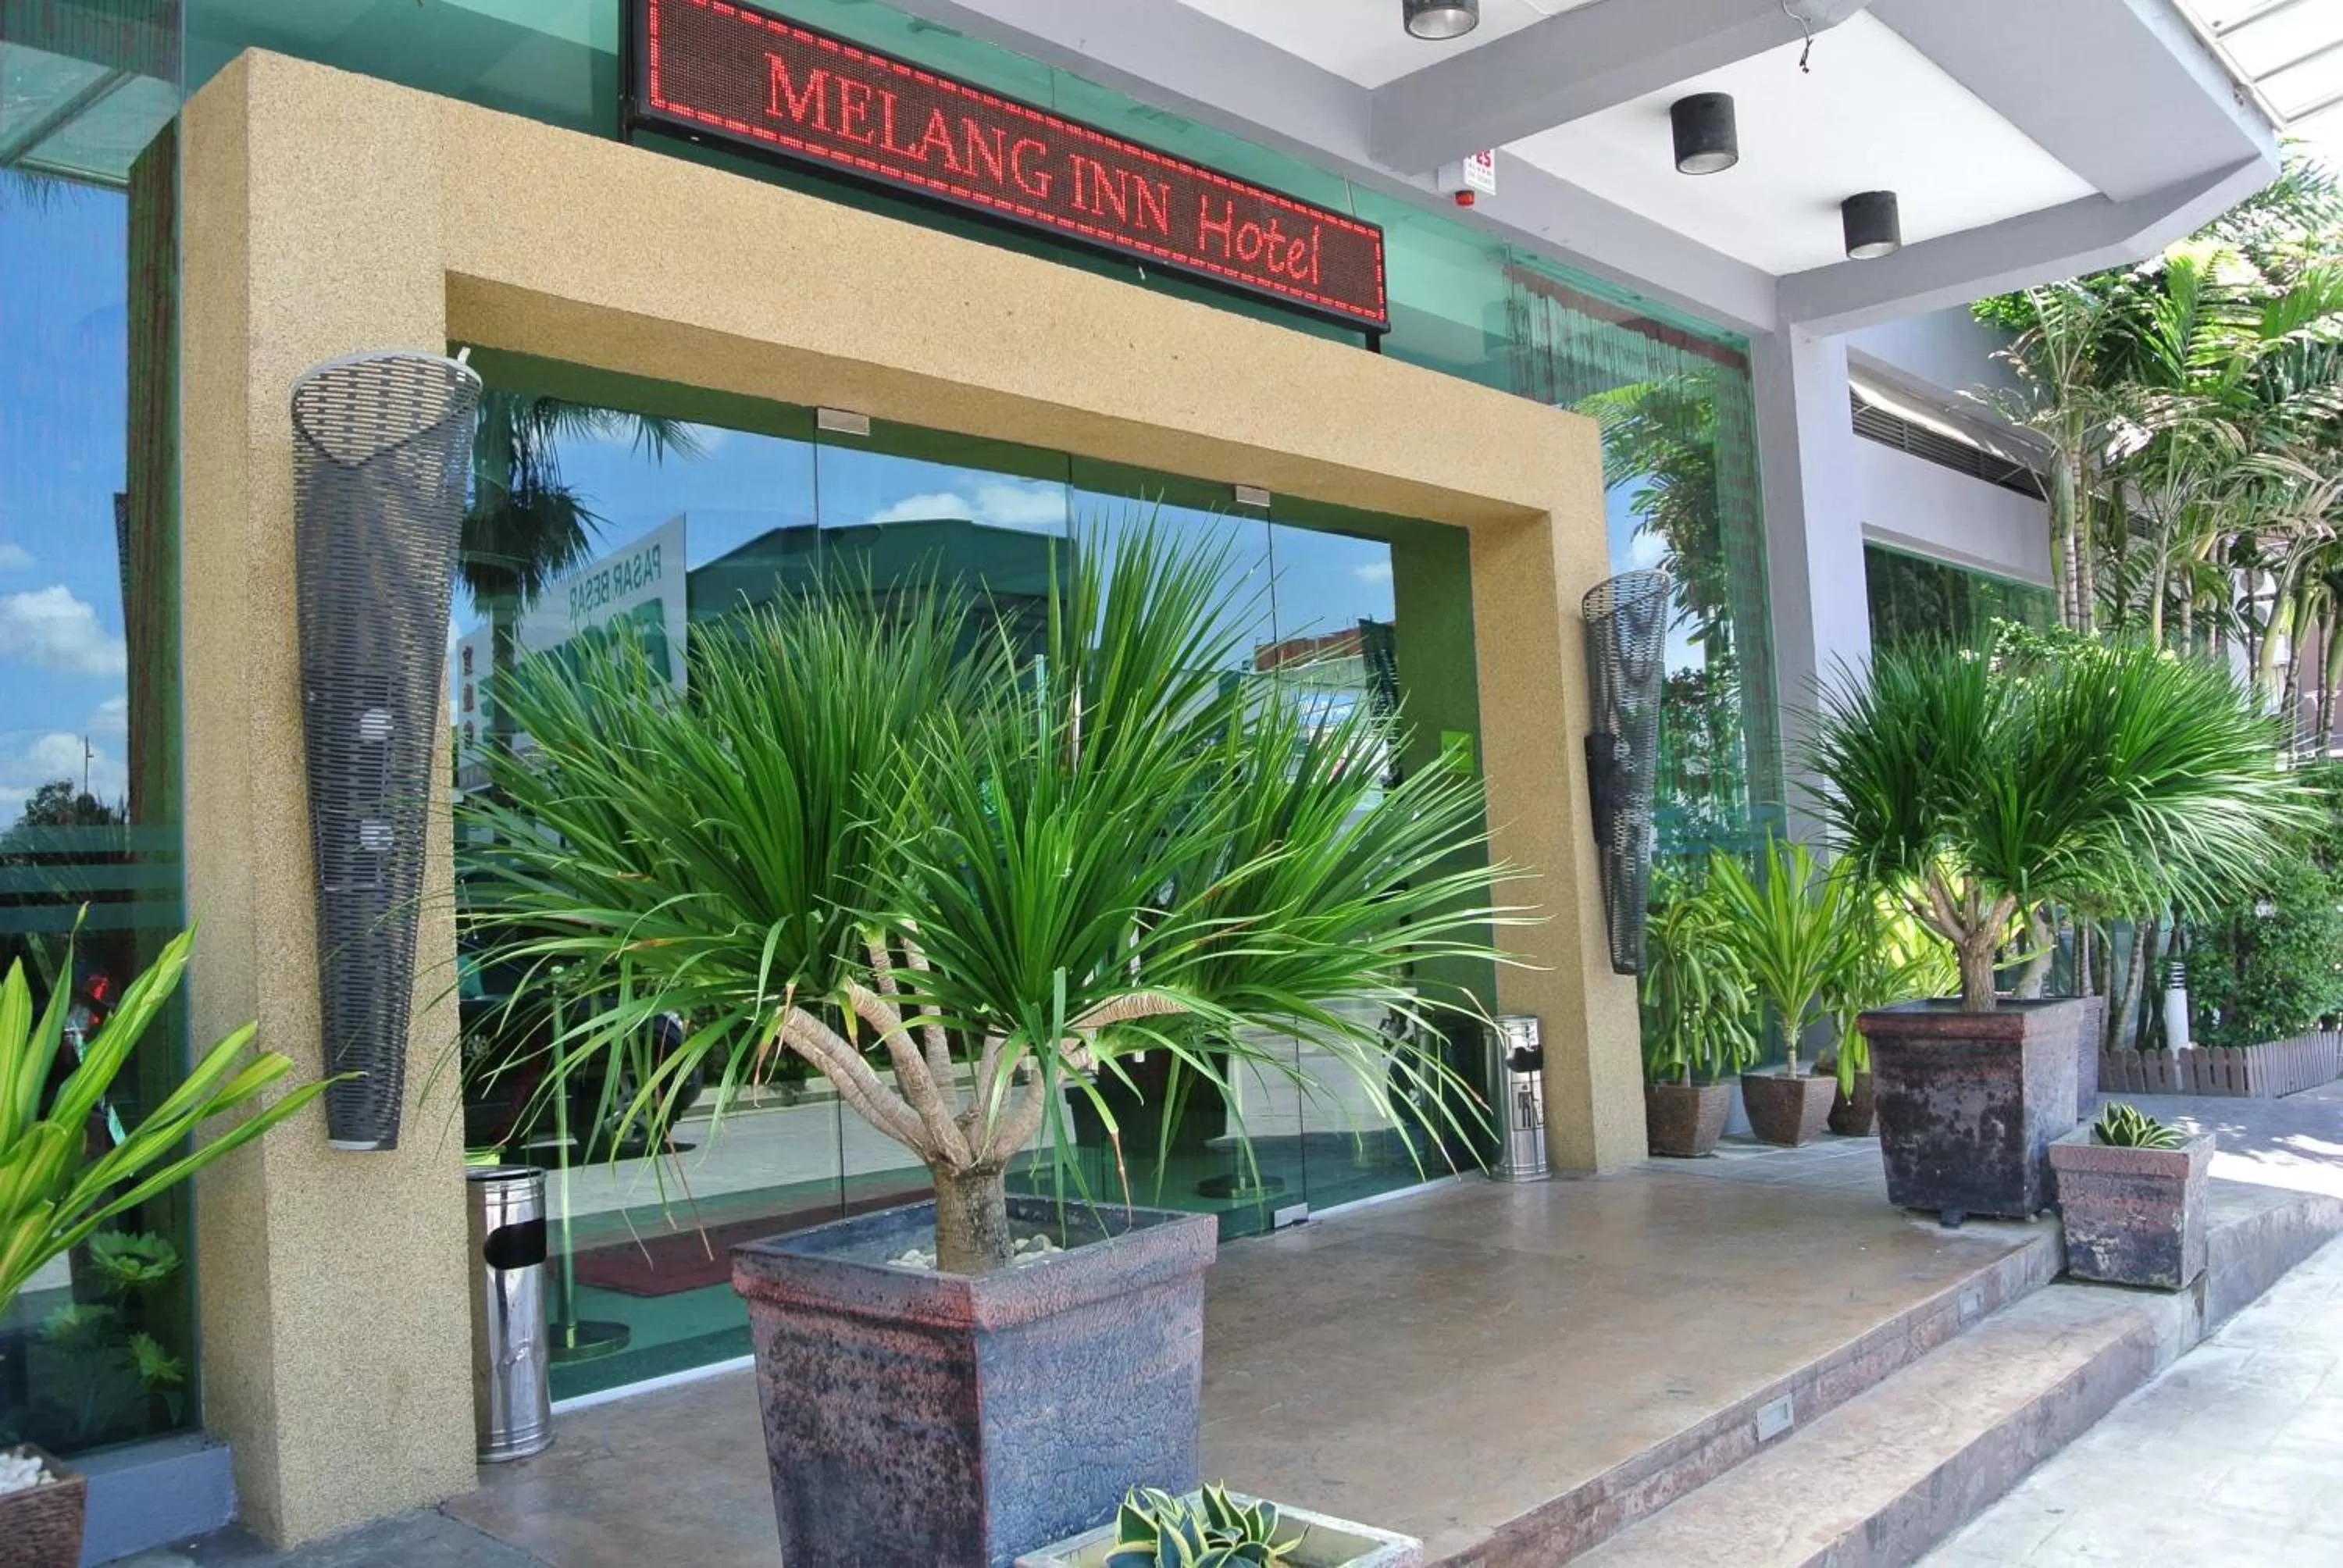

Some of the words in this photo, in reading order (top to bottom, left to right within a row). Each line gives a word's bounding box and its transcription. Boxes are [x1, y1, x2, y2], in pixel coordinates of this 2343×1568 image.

[763, 52, 1053, 199] MELANG
[1069, 156, 1172, 235] INN
[1196, 194, 1321, 286] Hotel
